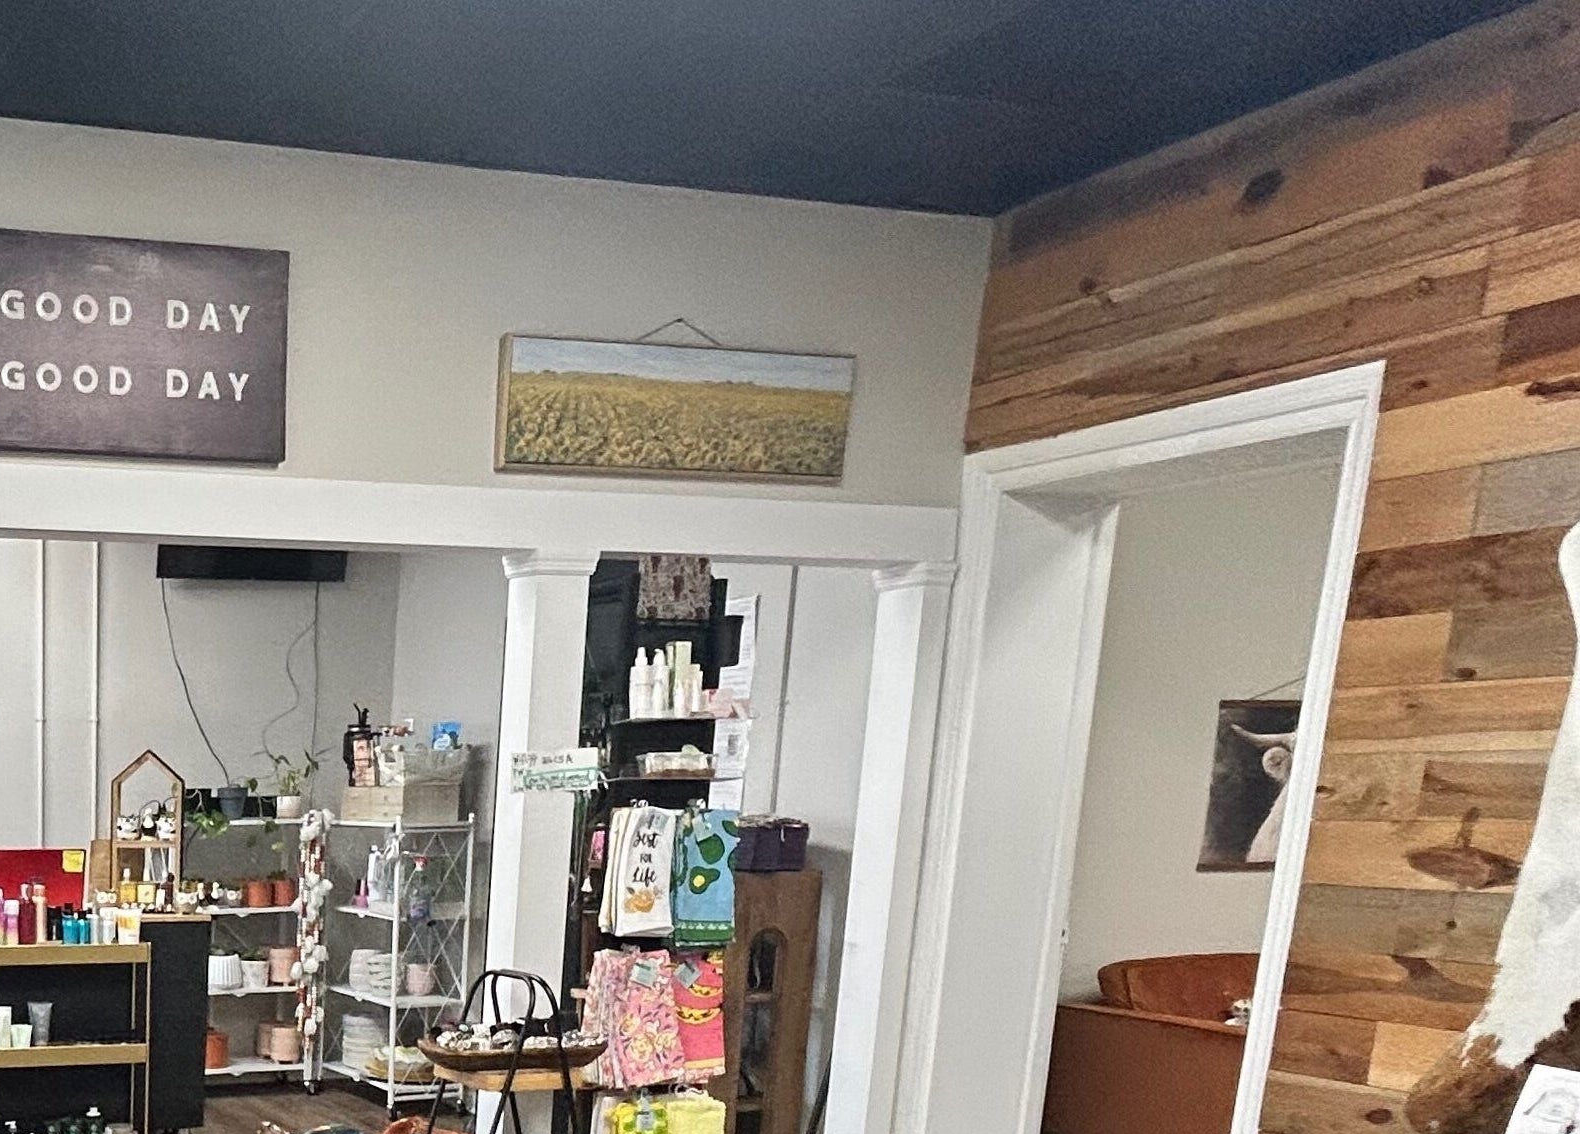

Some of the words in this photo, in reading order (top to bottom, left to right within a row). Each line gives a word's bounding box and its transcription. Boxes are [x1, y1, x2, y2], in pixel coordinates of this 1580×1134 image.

[0, 289, 132, 326] GOOD
[166, 300, 250, 333] DAY
[0, 361, 133, 395] GOOD
[166, 368, 249, 401] DAY
